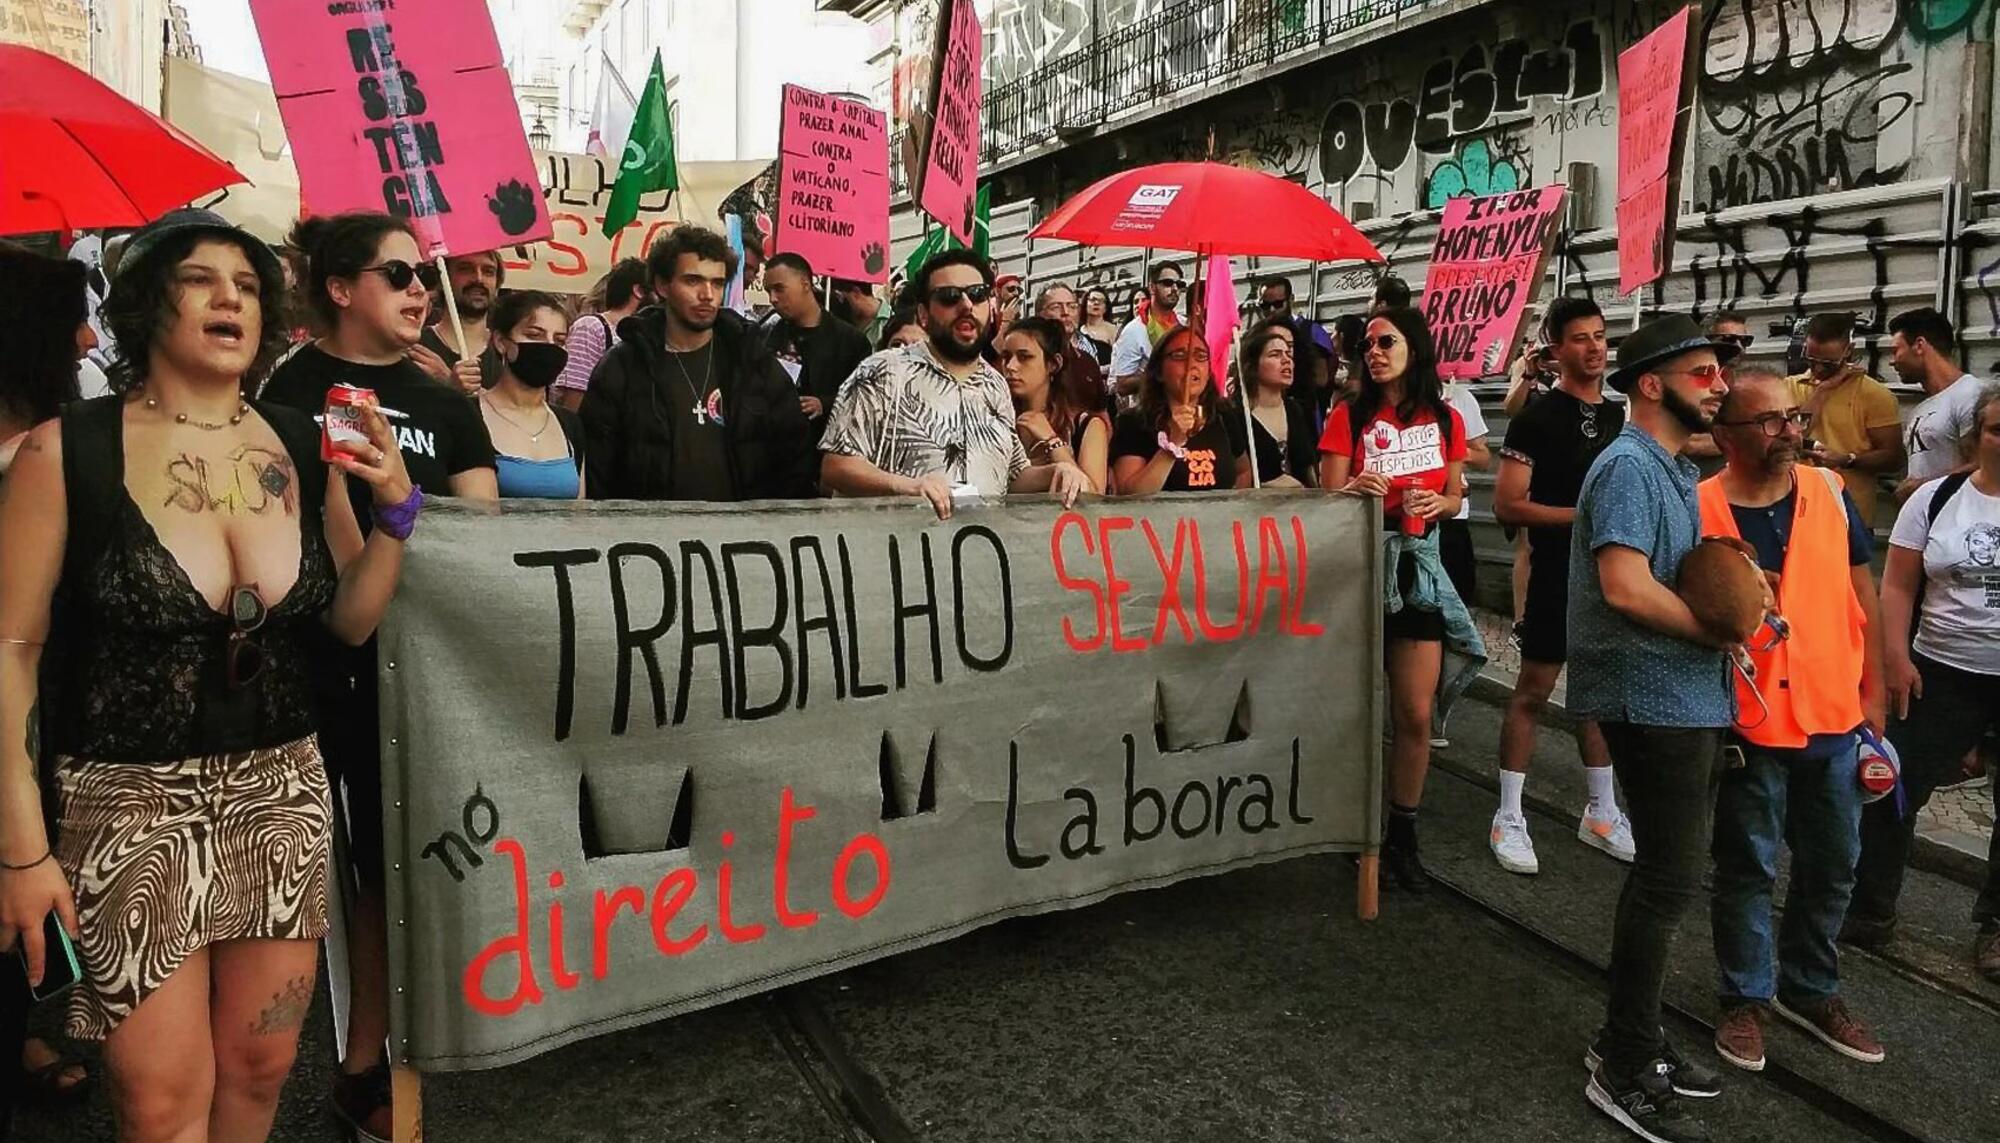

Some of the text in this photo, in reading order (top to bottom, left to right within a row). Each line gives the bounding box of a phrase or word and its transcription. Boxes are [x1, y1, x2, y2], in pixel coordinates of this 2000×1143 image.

[789, 88, 826, 110] CONTRA
[799, 112, 869, 141] PRAZER ANAL
[811, 141, 852, 163] CONTRA
[933, 129, 963, 187] REGRAS
[827, 161, 836, 174] O
[791, 190, 835, 212] PRAZER
[1139, 188, 1182, 198] GAT
[1425, 279, 1517, 328] BRUNO
[1407, 427, 1436, 446] STOP
[513, 512, 1327, 742] TRABALHO SEXUAL
[463, 786, 891, 1017] direito
